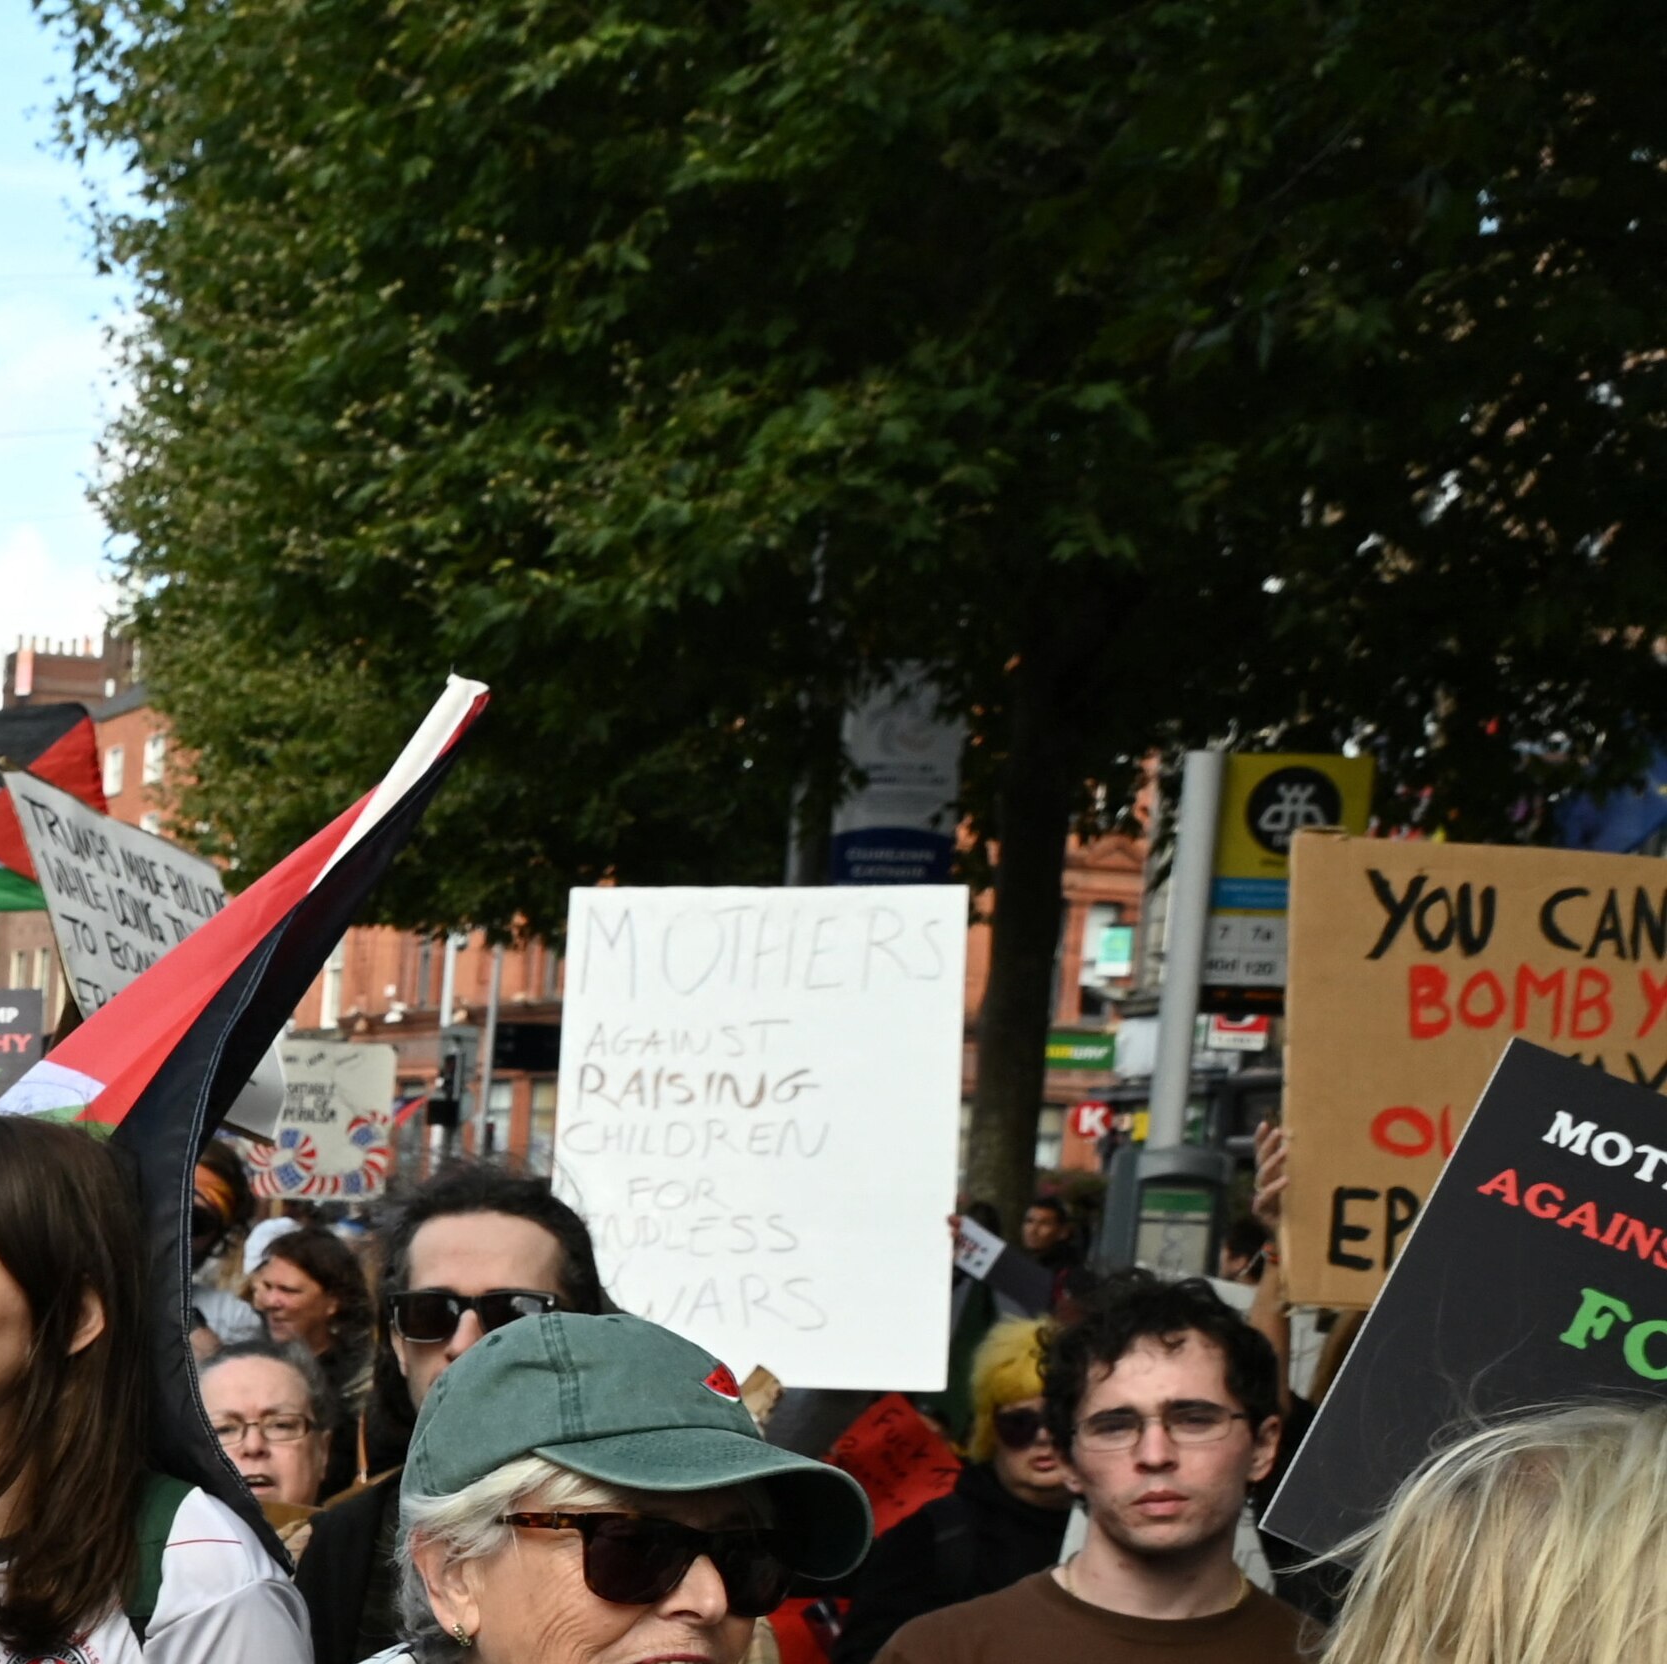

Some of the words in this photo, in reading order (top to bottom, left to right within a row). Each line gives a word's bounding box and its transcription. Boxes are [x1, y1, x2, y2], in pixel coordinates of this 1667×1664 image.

[1365, 867, 1497, 960] YOU
[579, 904, 944, 998] MOTHERS
[1409, 962, 1614, 1041] BOMB
[583, 1020, 790, 1058] AGAINST
[576, 1062, 819, 1111] RAISING
[561, 1119, 830, 1159] CHILDREN
[1542, 1110, 1667, 1190] MOT
[628, 1177, 731, 1211] FOR
